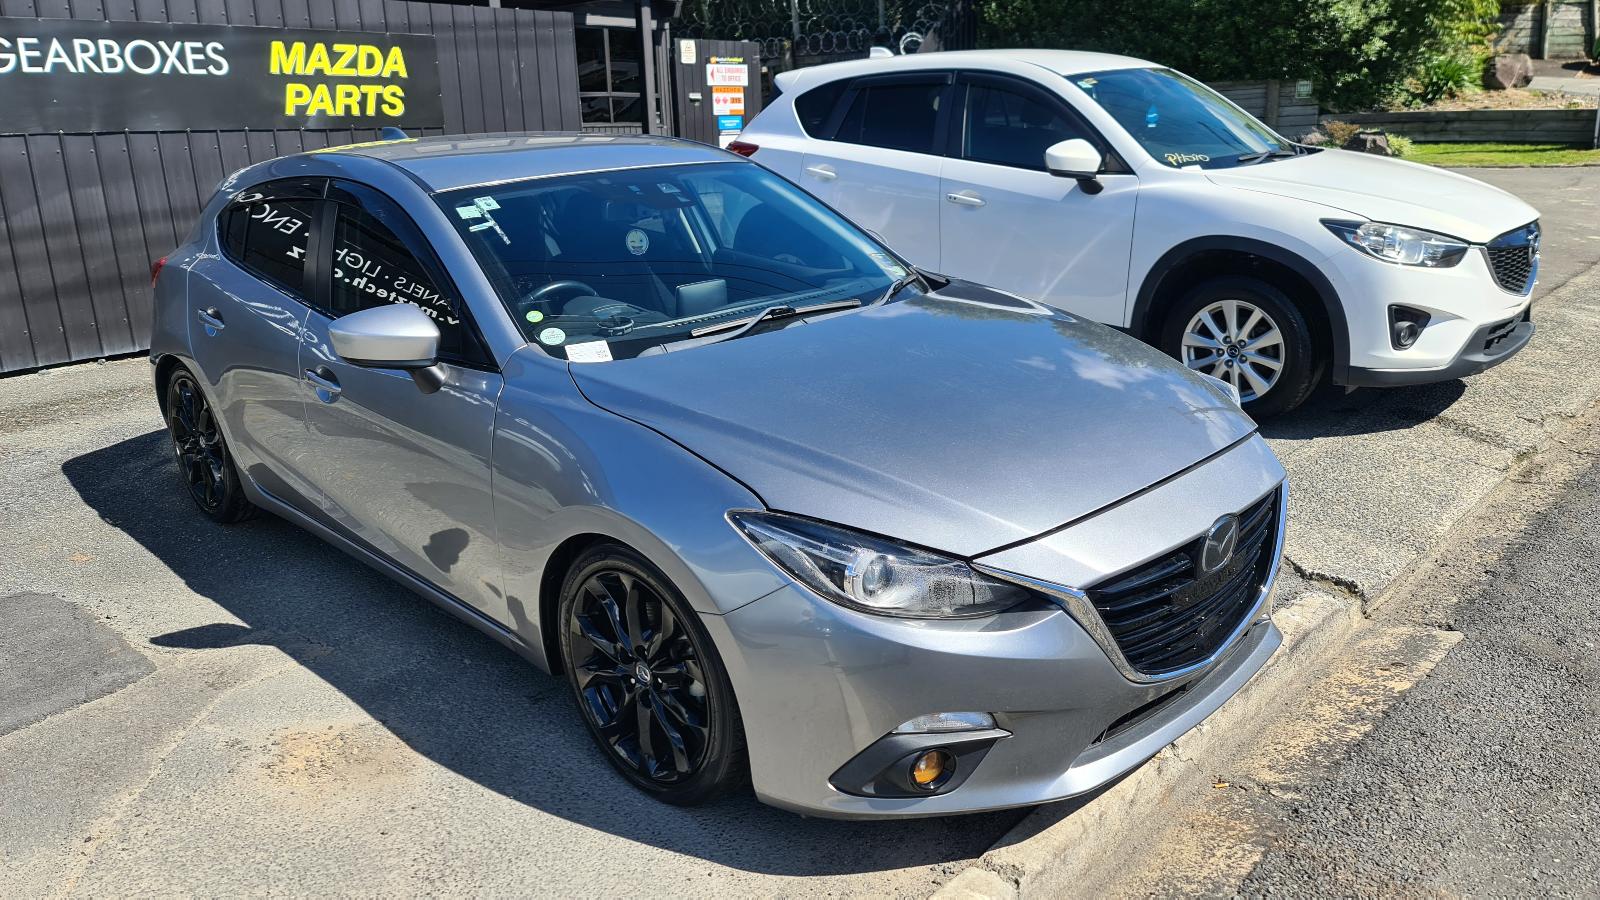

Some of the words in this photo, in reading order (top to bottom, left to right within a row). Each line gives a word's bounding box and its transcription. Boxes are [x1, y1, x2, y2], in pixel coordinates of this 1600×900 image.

[0, 37, 229, 77] GEARBOXES
[269, 40, 408, 78] MAZDA
[284, 83, 406, 117] PARTS
